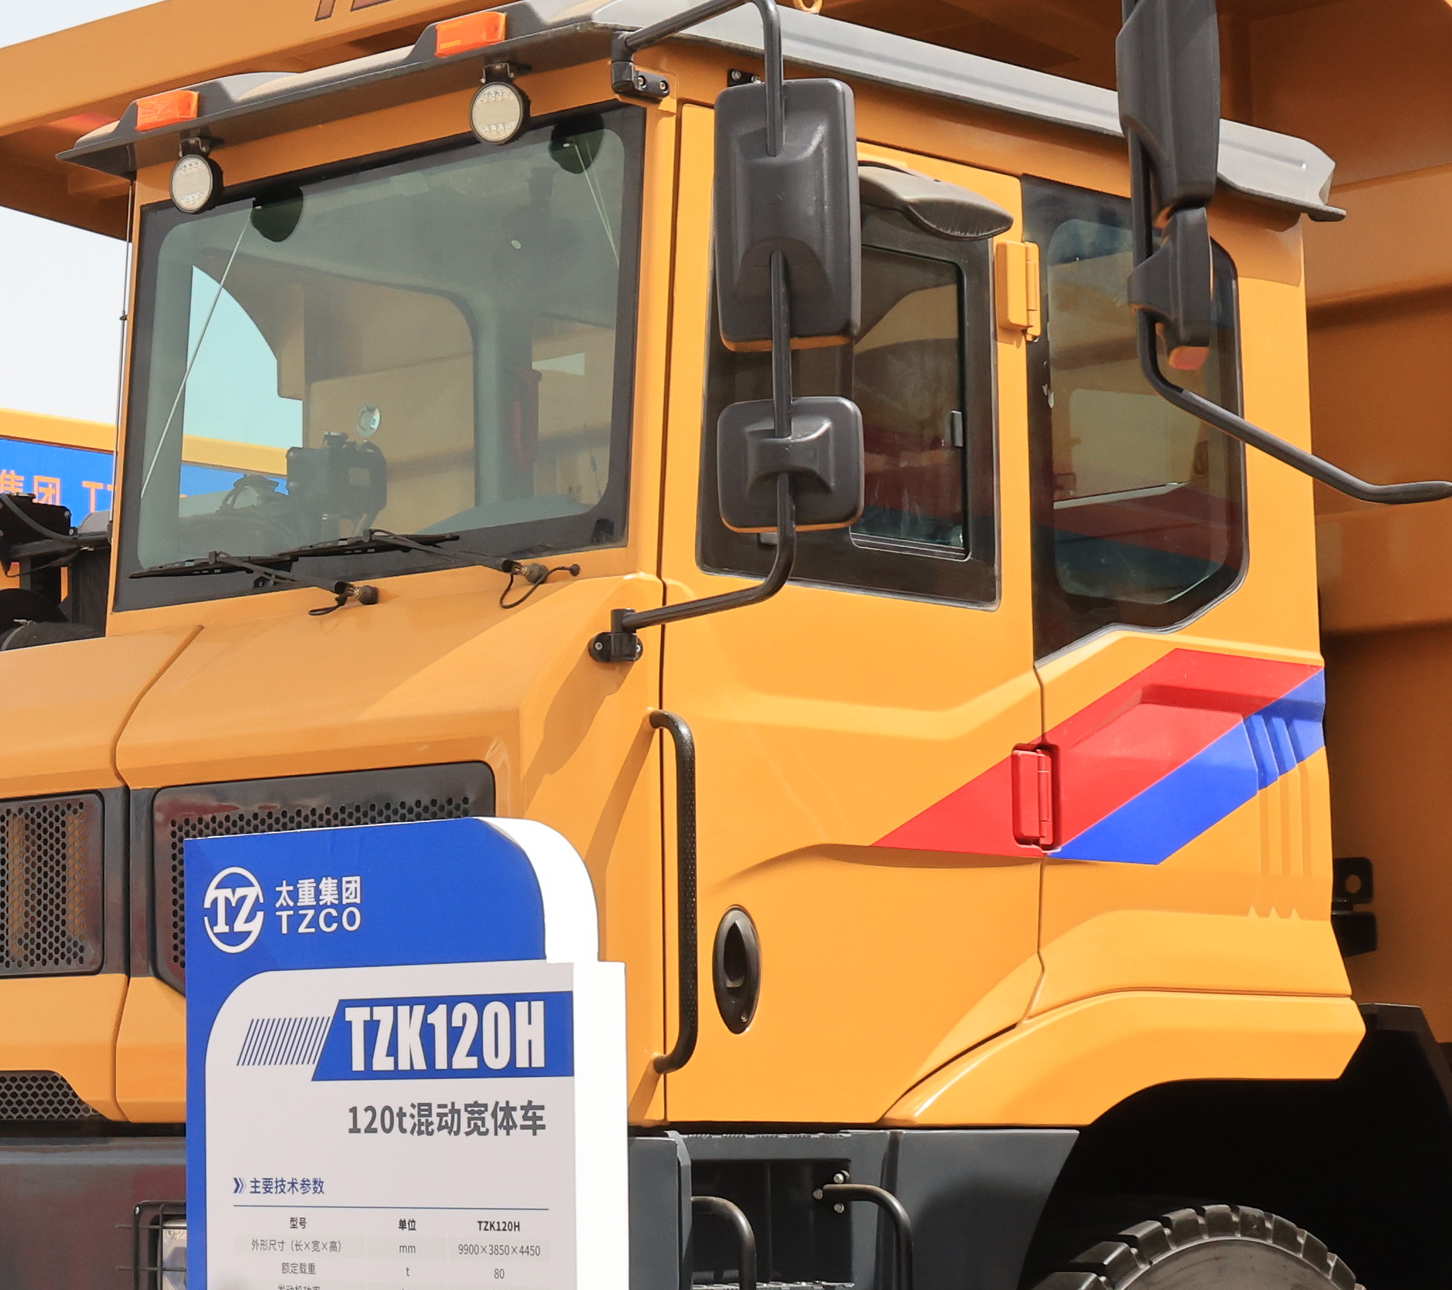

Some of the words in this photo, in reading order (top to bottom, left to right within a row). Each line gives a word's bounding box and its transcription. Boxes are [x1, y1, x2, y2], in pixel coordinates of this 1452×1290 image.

[275, 875, 362, 906] 太重集团
[275, 907, 362, 934] TZCO
[344, 1000, 546, 1072] TZK120H
[347, 1099, 546, 1136] 120t混动宽体车
[249, 1177, 325, 1196] 主要技术参数
[289, 1216, 307, 1230] 型号
[398, 1218, 417, 1232] 单位
[477, 1220, 521, 1233] TZK120H
[399, 1243, 417, 1254] mm
[281, 1262, 316, 1276] 额定载重
[493, 1268, 505, 1280] 80
